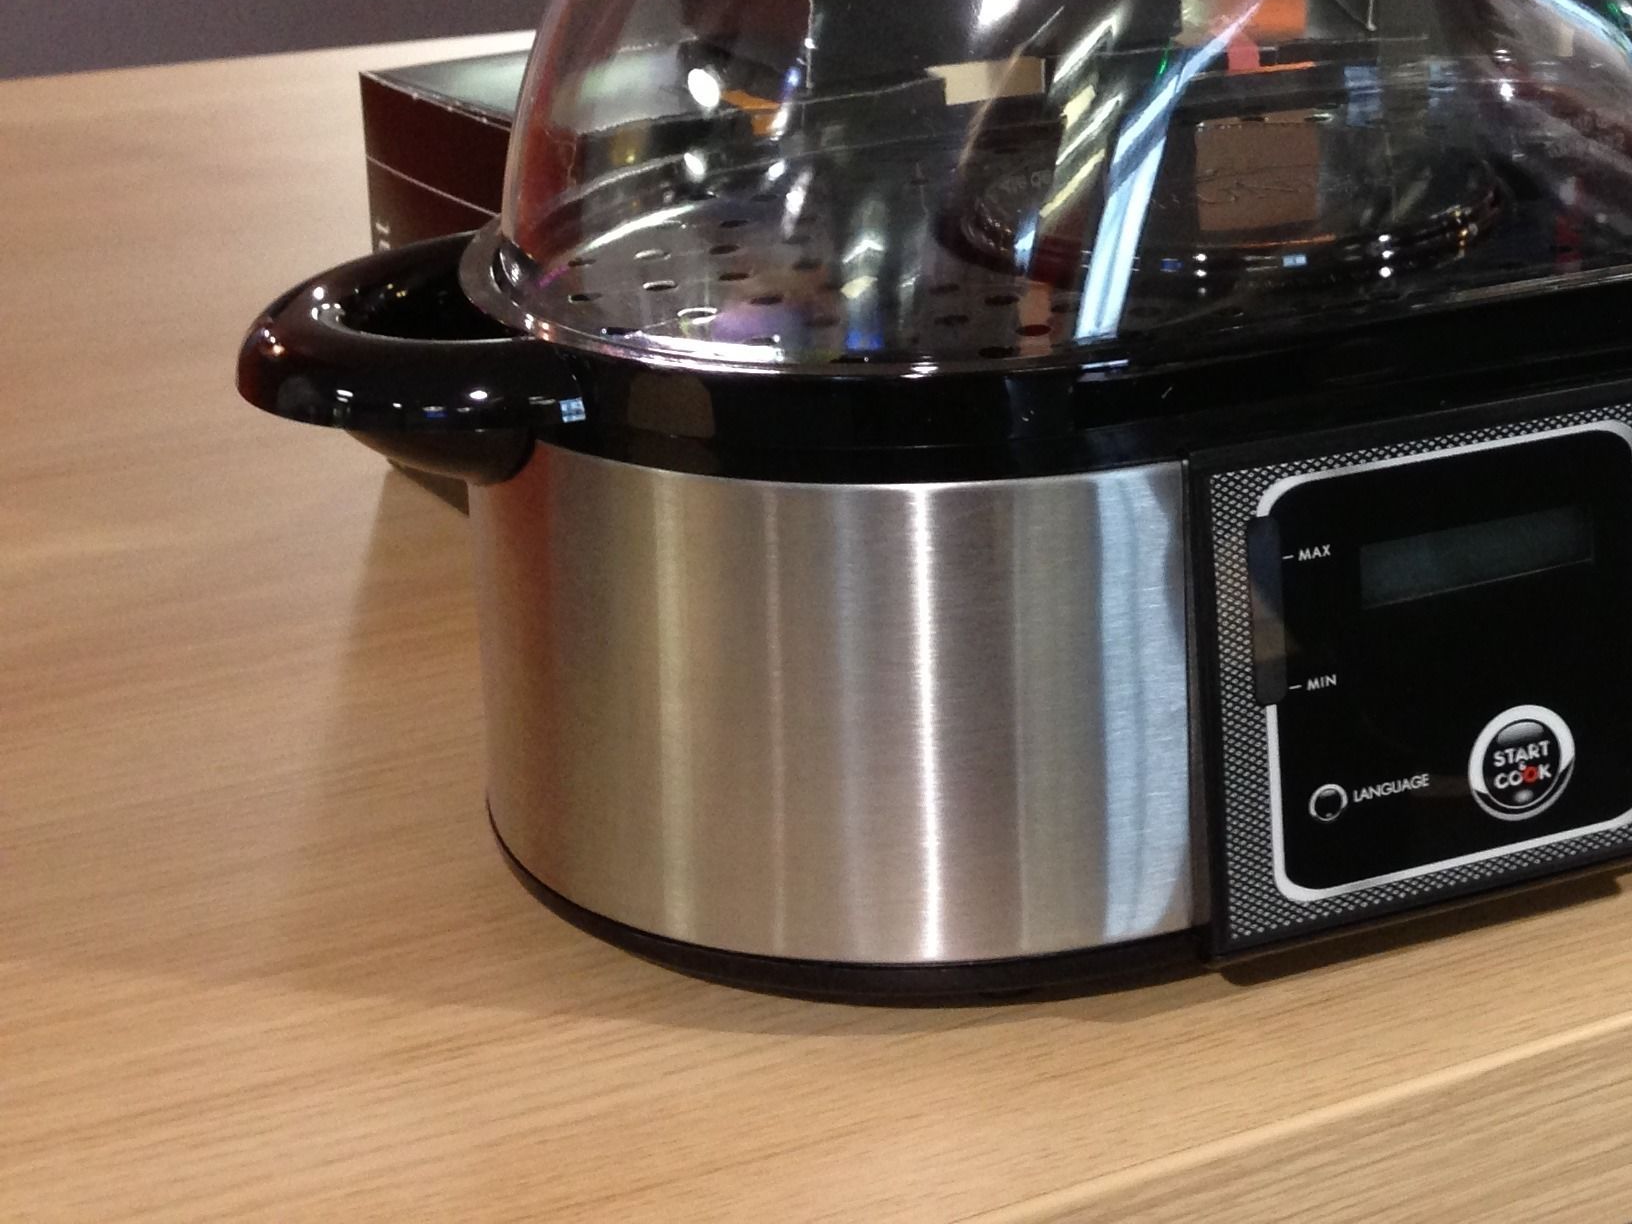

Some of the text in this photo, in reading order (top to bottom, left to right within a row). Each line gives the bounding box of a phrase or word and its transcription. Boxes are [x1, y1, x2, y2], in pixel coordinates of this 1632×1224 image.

[1298, 544, 1331, 561] MAX
[1307, 674, 1337, 691] MIN
[1494, 740, 1550, 767] START
[1353, 774, 1430, 803] LANGUAGE
[1494, 763, 1552, 789] COOK
